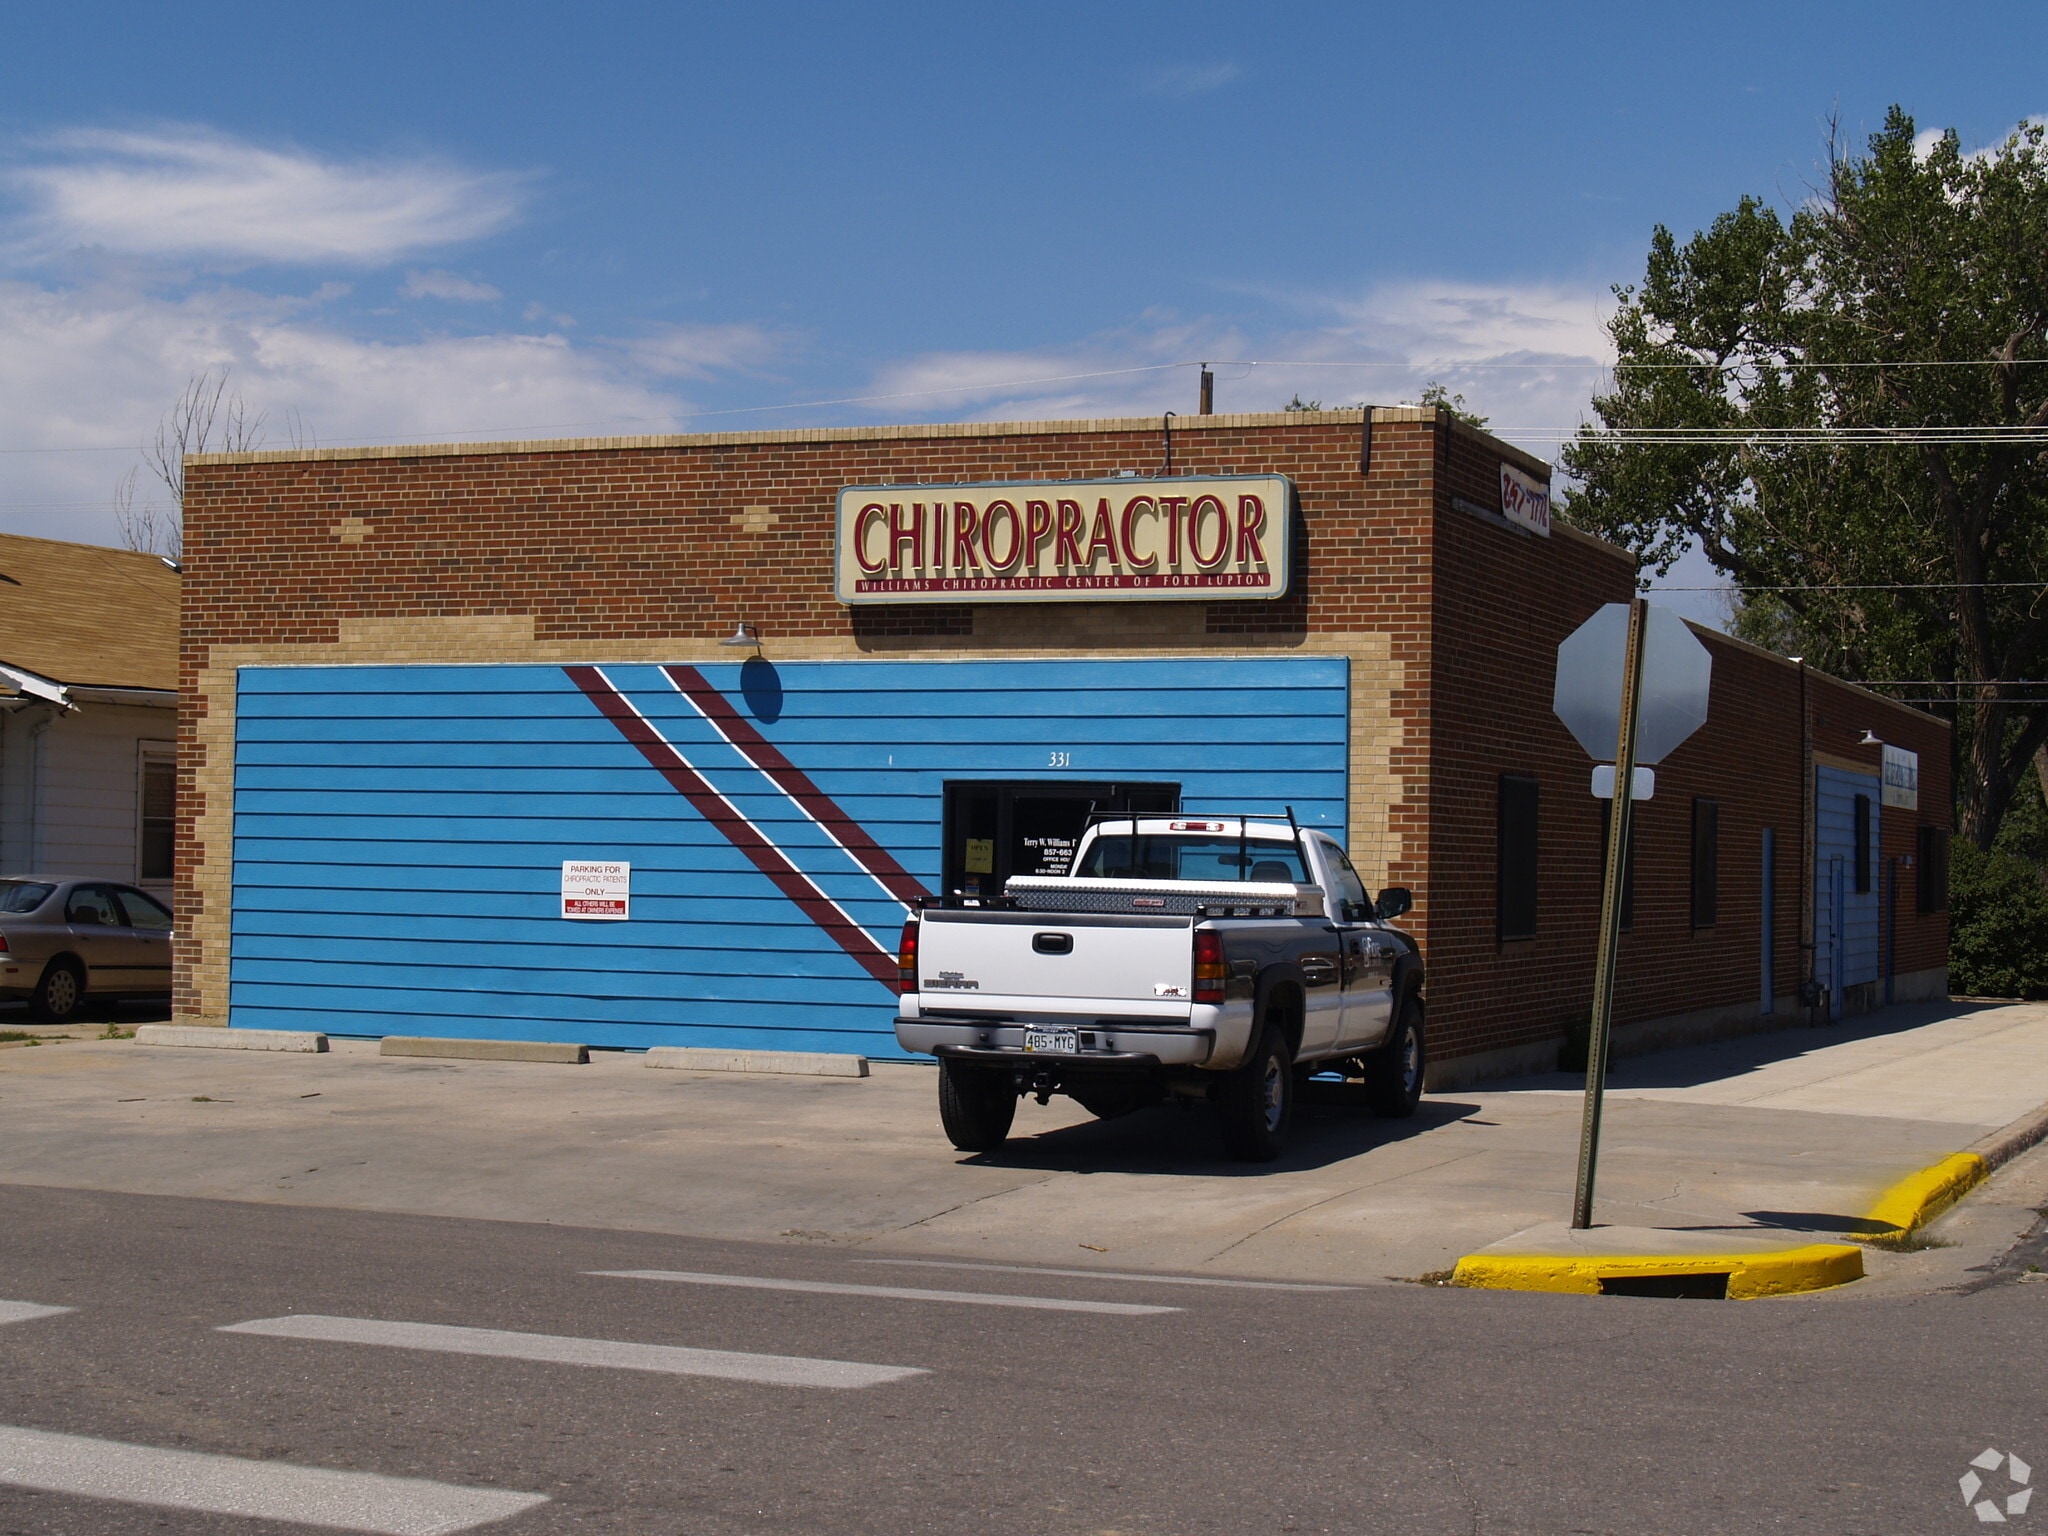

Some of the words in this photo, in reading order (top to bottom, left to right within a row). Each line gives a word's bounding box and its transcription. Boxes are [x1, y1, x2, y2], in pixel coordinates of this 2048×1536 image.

[854, 494, 1267, 573] CHIROPRACTOR
[861, 580, 930, 591] WILLIAMS
[942, 578, 1052, 590] CHIROPRACTIC
[1065, 577, 1120, 588] CENTER
[1133, 576, 1150, 586] OF
[1163, 575, 1199, 586] FORT
[1207, 574, 1265, 585] LUPTON
[1048, 752, 1070, 767] 331
[1024, 838, 1038, 848] Terry
[1047, 838, 1070, 847] Williams
[1043, 848, 1073, 856] 857-663
[570, 865, 603, 874] PARKING
[605, 866, 621, 874] FOR
[564, 875, 601, 883] CHIROPRACTIC
[585, 888, 605, 896] ONLY
